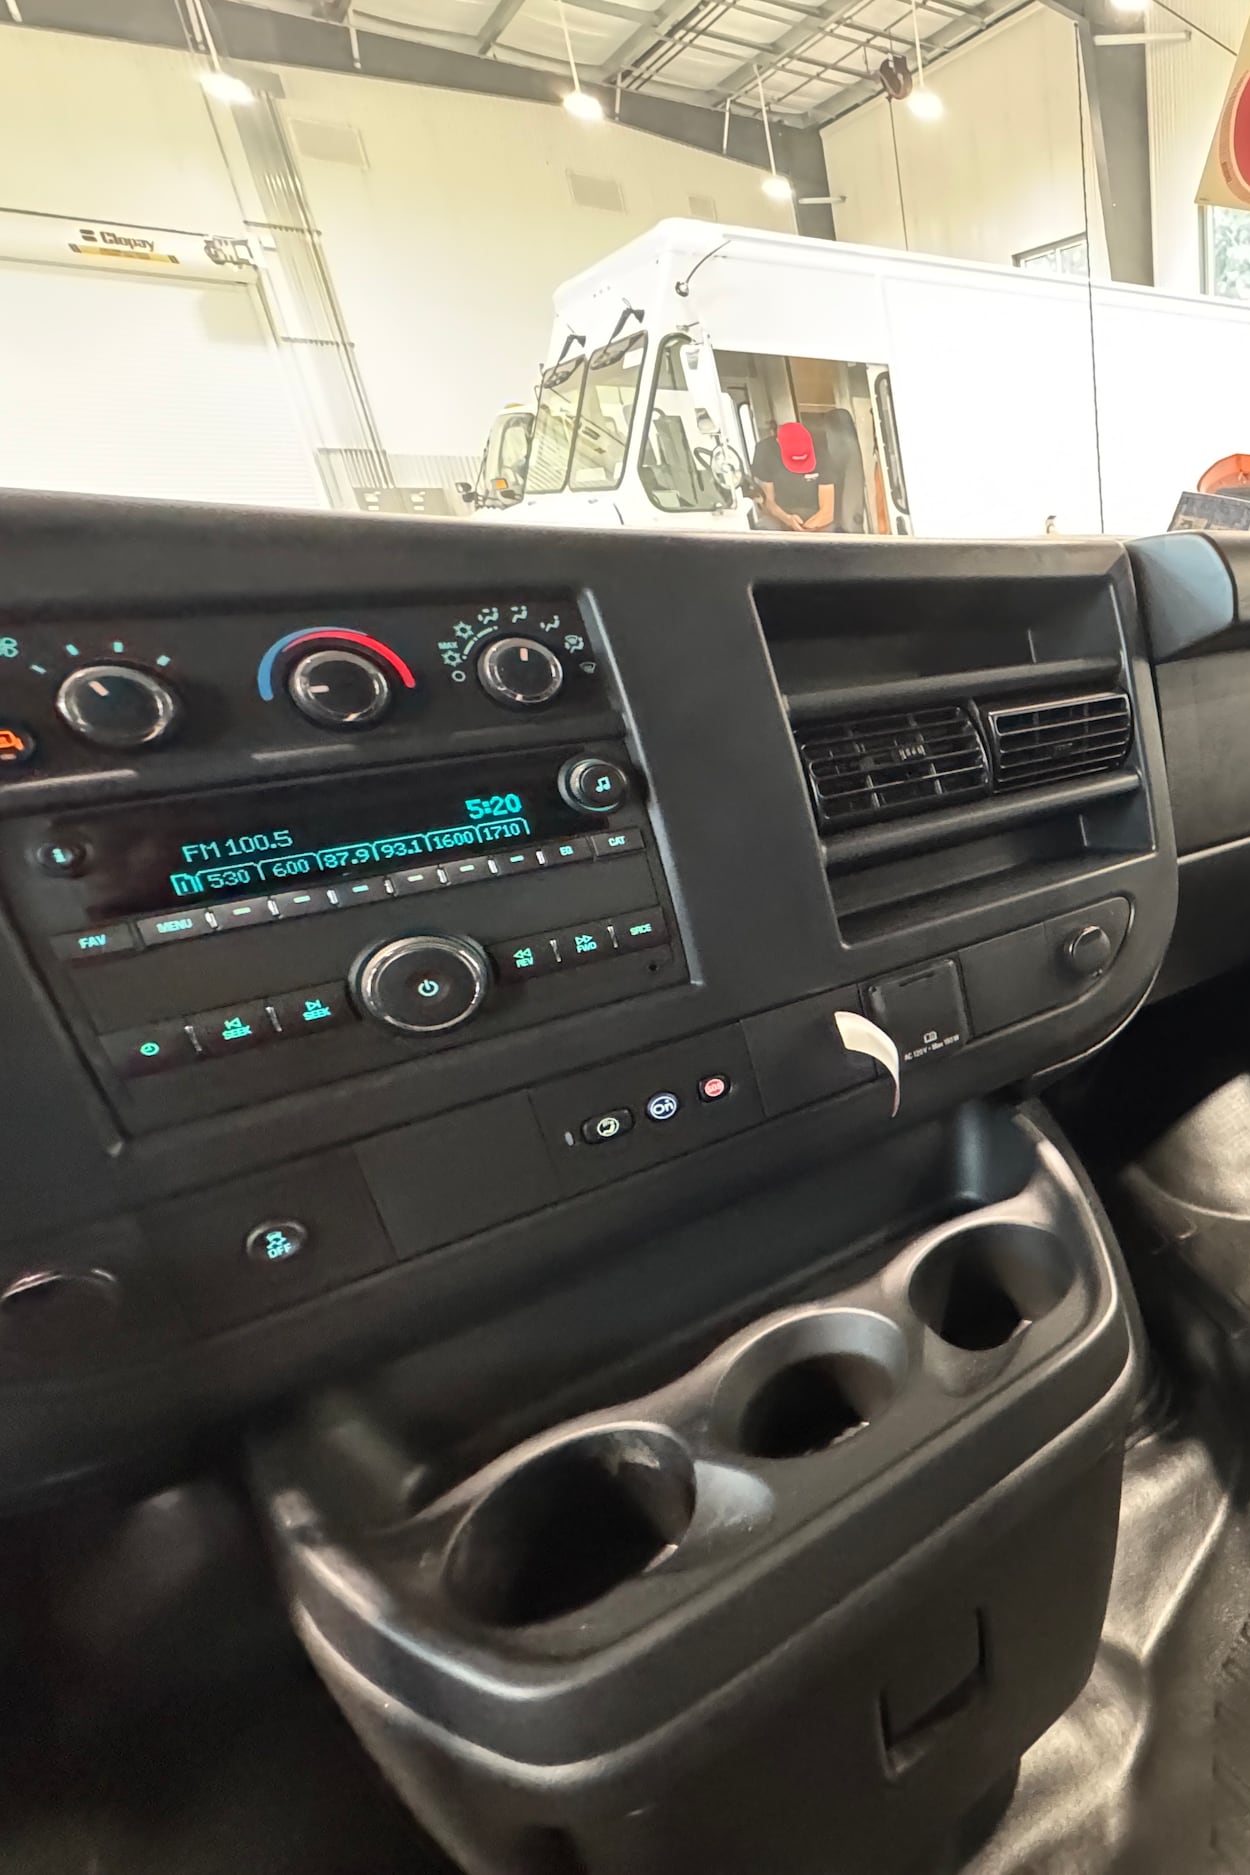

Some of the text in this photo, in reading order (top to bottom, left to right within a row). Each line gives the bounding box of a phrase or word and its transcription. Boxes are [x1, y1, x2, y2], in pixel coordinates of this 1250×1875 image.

[99, 231, 154, 252] Clopay
[465, 793, 522, 819] 5:20
[181, 829, 293, 863] FM 100.5
[608, 836, 626, 847] CAT
[206, 869, 251, 889] 530
[272, 858, 310, 878] 600
[323, 848, 370, 869] 87.9
[381, 840, 422, 859] 93.1
[433, 830, 475, 850] 1600
[483, 822, 521, 841] 1710
[156, 918, 193, 933] MENU
[78, 934, 107, 949] FAV
[576, 941, 597, 954] FWD
[516, 956, 534, 968] REV
[302, 1006, 331, 1021] SEEK
[222, 1024, 252, 1040] SEEK
[267, 1242, 292, 1259] OFF
